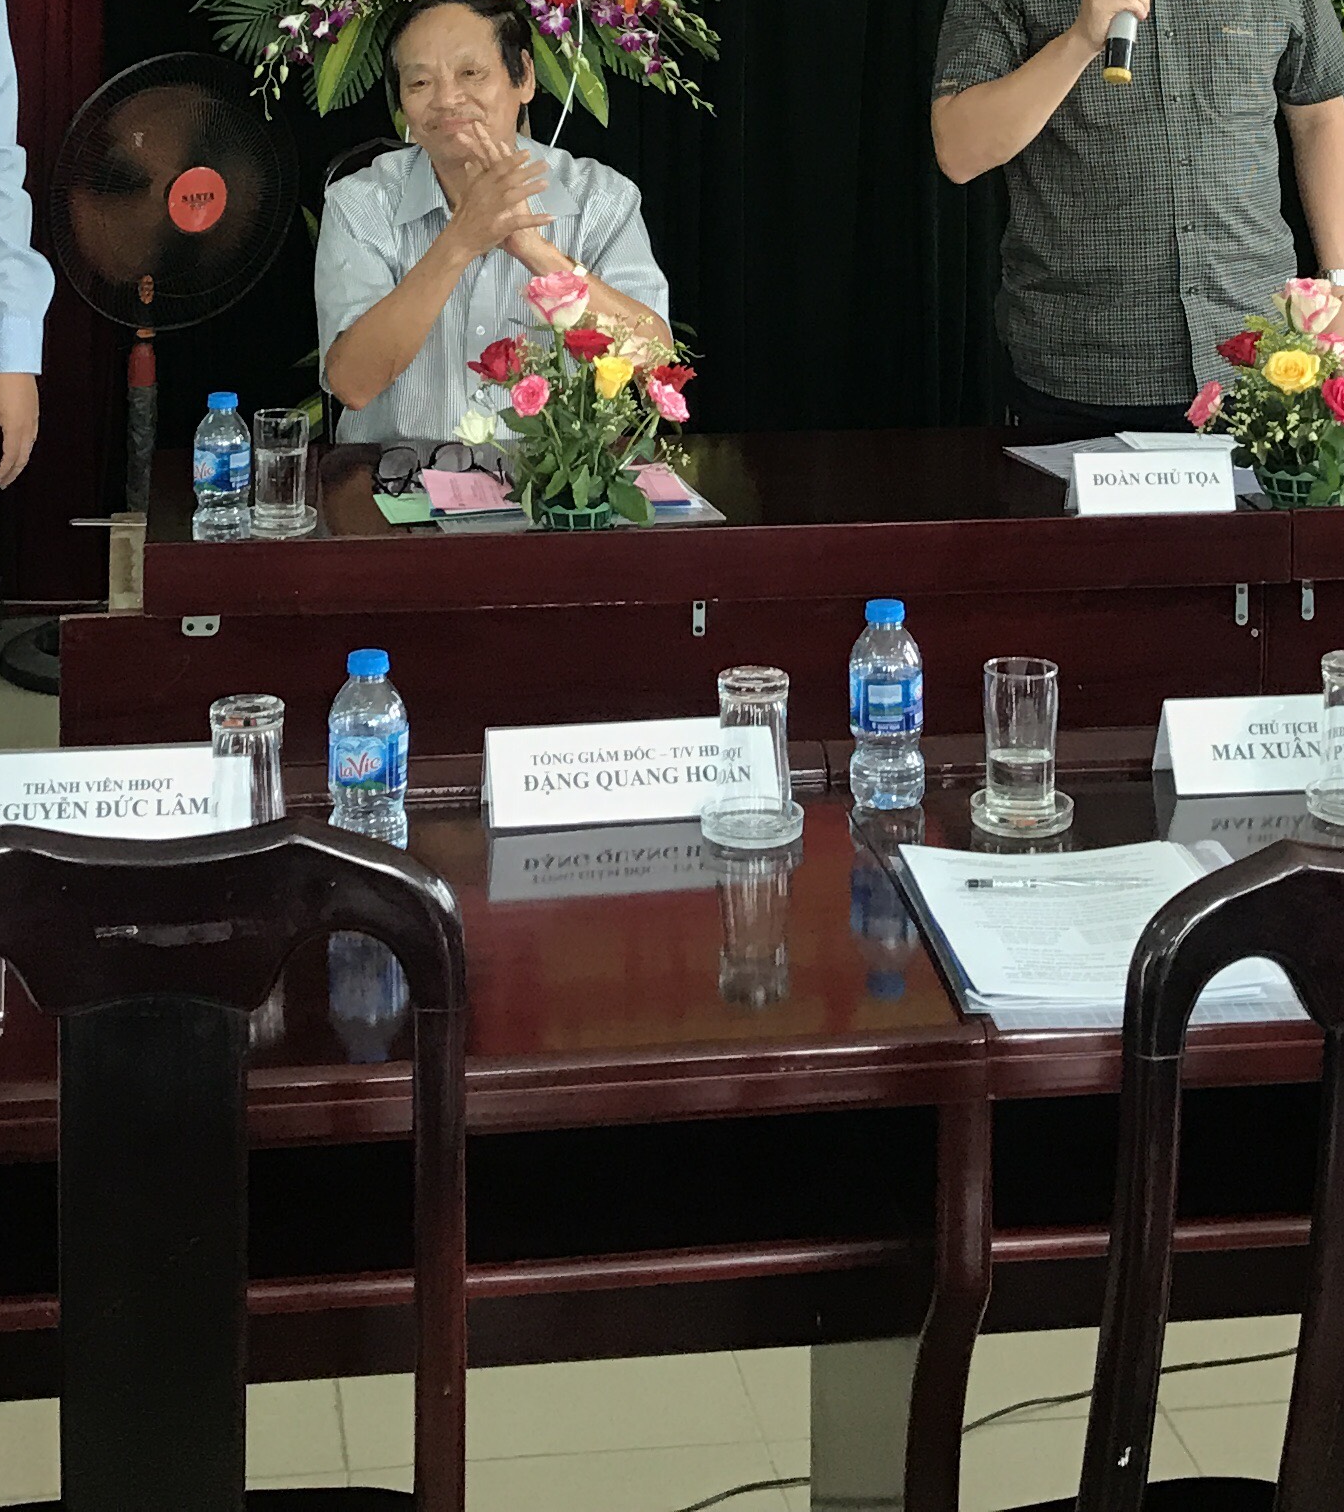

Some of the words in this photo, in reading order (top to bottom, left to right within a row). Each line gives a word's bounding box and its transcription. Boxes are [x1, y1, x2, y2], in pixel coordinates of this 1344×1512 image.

[194, 463, 215, 479] Vie
[1093, 470, 1140, 486] ĐOÀN
[1145, 469, 1181, 485] CHỦ
[1185, 471, 1220, 487] TỌA
[1248, 720, 1278, 736] CHỦ
[1283, 721, 1318, 738] TỊCH
[578, 747, 619, 764] GIÁM
[670, 746, 694, 759] T/V
[1211, 743, 1255, 761] MAI
[1261, 737, 1321, 759] XUÂN
[24, 778, 80, 795] THÀNH
[86, 776, 124, 793] VIÊN
[128, 777, 173, 792] HĐQT
[524, 769, 590, 795] ĐẶNG
[596, 766, 679, 791] QUANG
[686, 762, 751, 785] HOÀN
[95, 796, 149, 819] ĐỨC
[156, 792, 210, 816] LÂM
